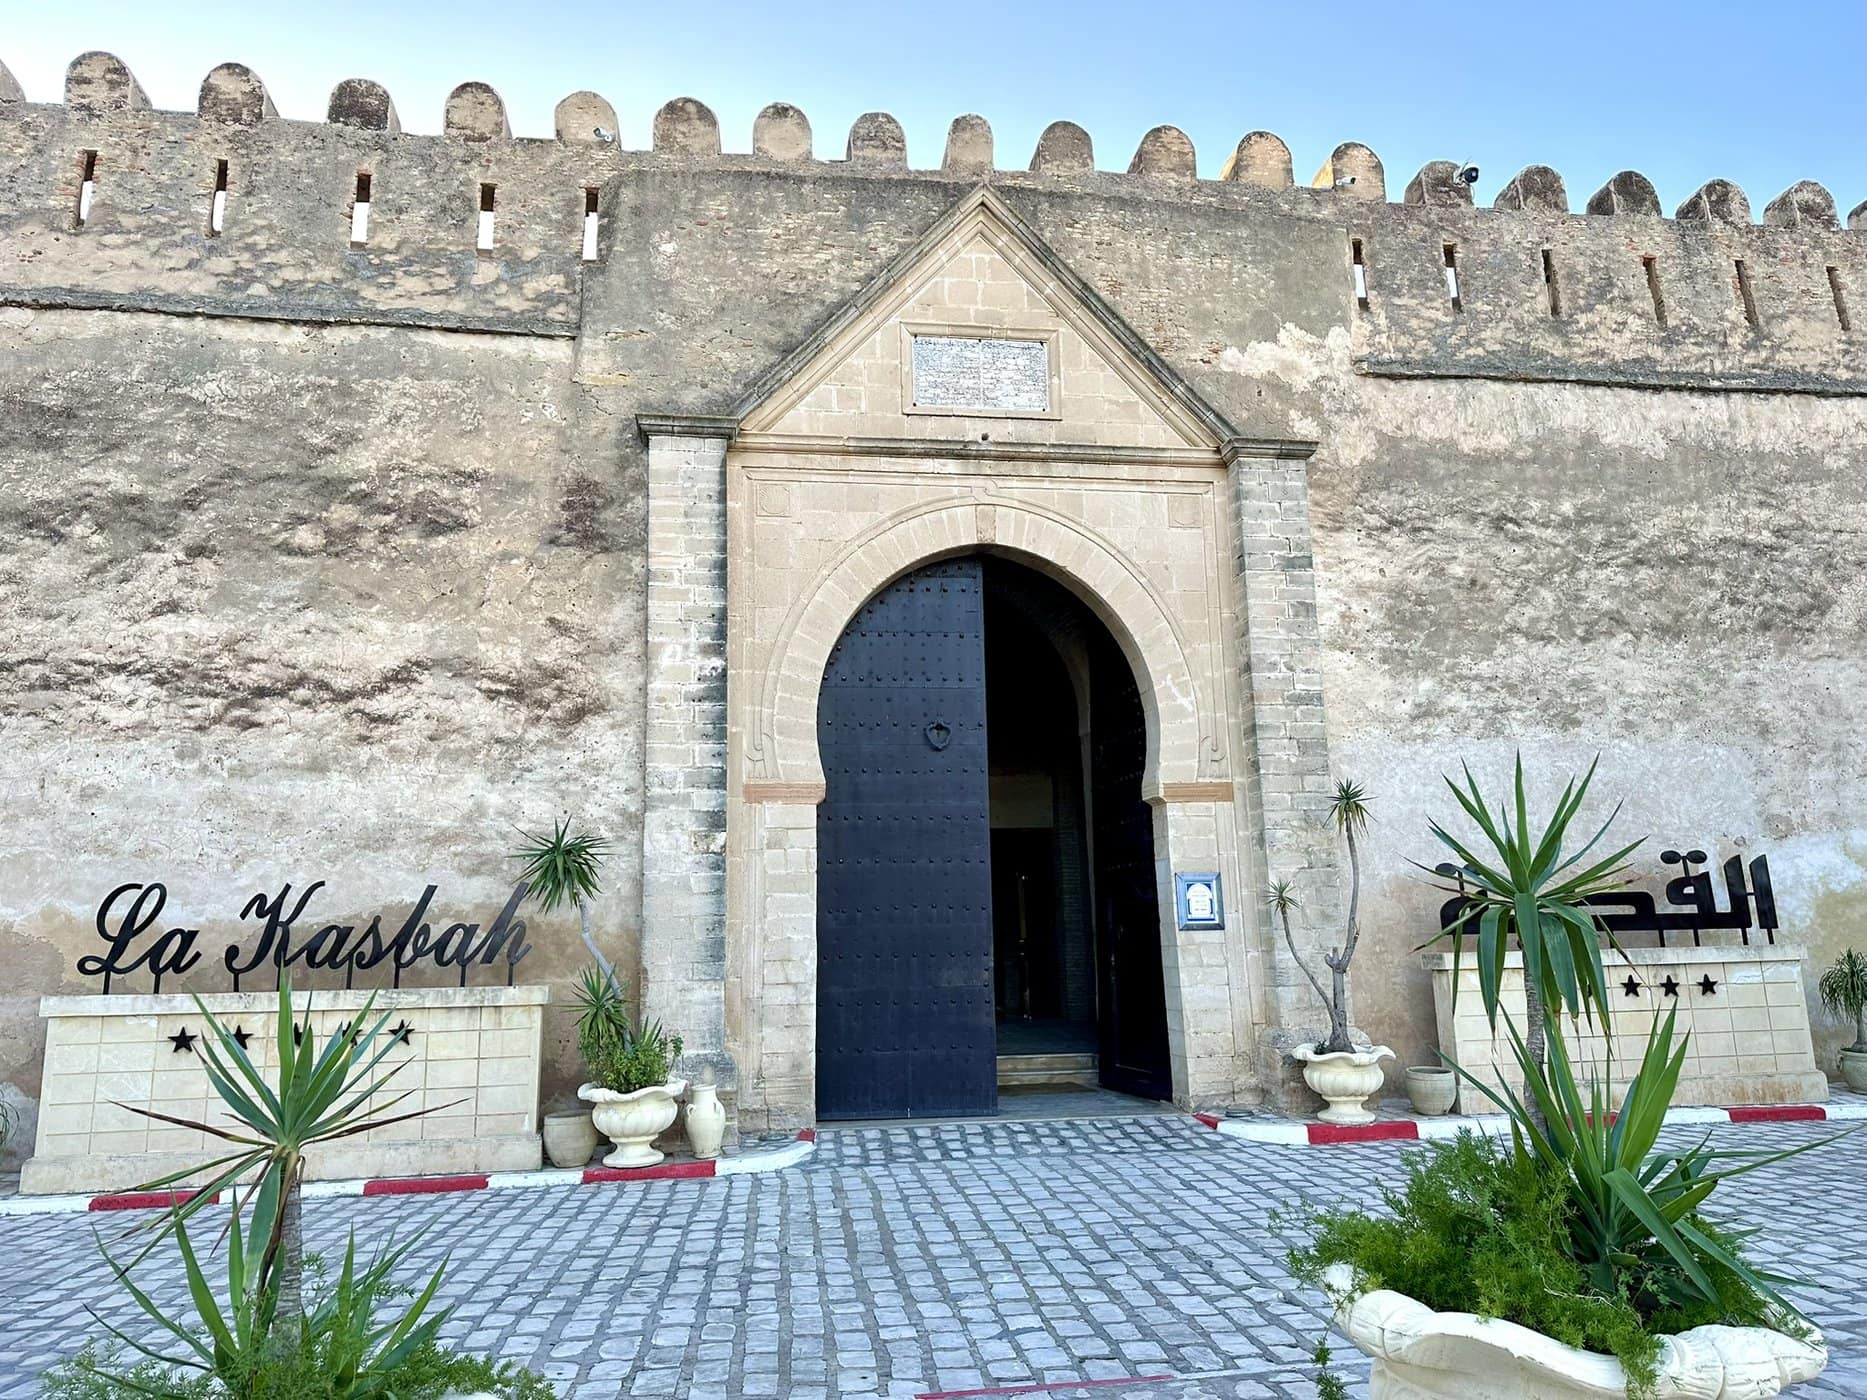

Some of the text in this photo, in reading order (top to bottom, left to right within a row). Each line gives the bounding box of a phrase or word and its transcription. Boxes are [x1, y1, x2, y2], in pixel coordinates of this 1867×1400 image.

[77, 880, 532, 975] La Kasbah
[1435, 850, 1779, 934] القصة
